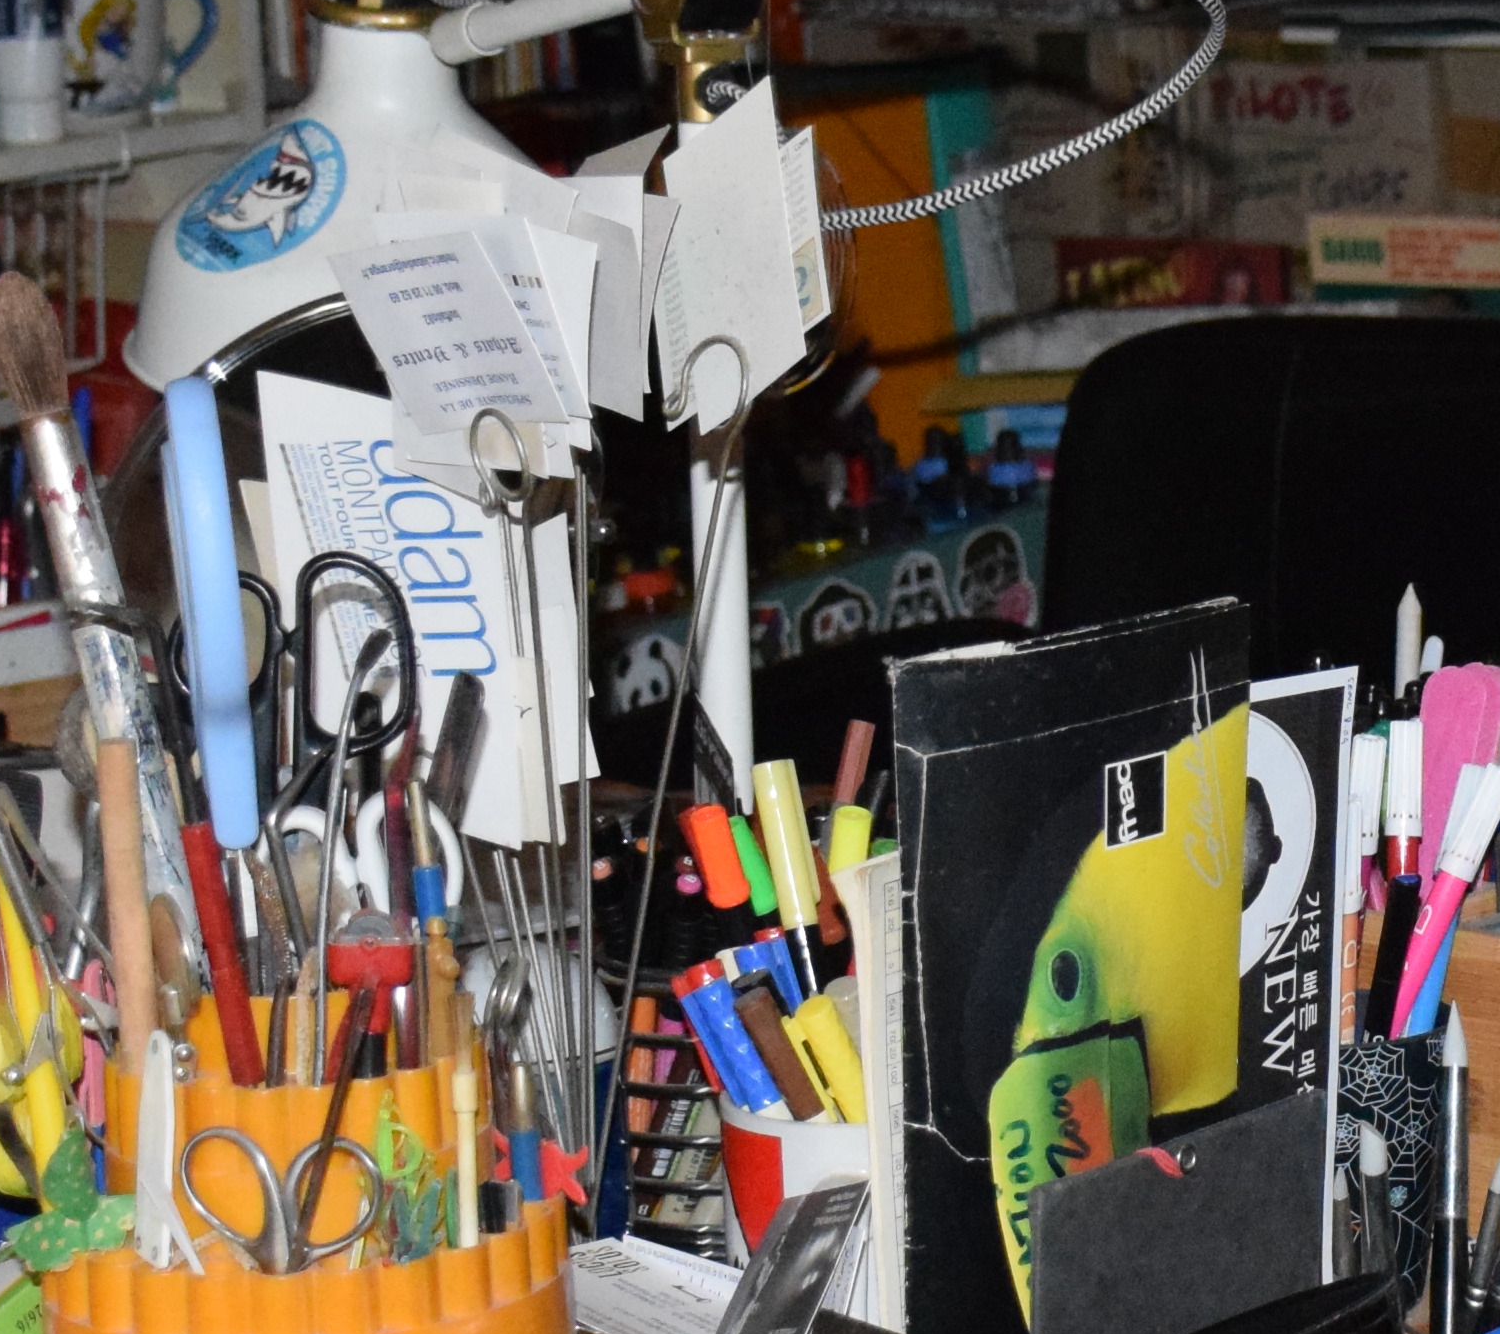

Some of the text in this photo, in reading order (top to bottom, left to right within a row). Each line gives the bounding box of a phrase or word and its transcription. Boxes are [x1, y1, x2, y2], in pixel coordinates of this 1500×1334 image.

[472, 334, 521, 357] Achats
[315, 442, 357, 551] TOUT POUR
[1111, 759, 1139, 846] fnac
[1262, 915, 1300, 1079] NEW
[1296, 891, 1322, 1033] 가장 빠른
